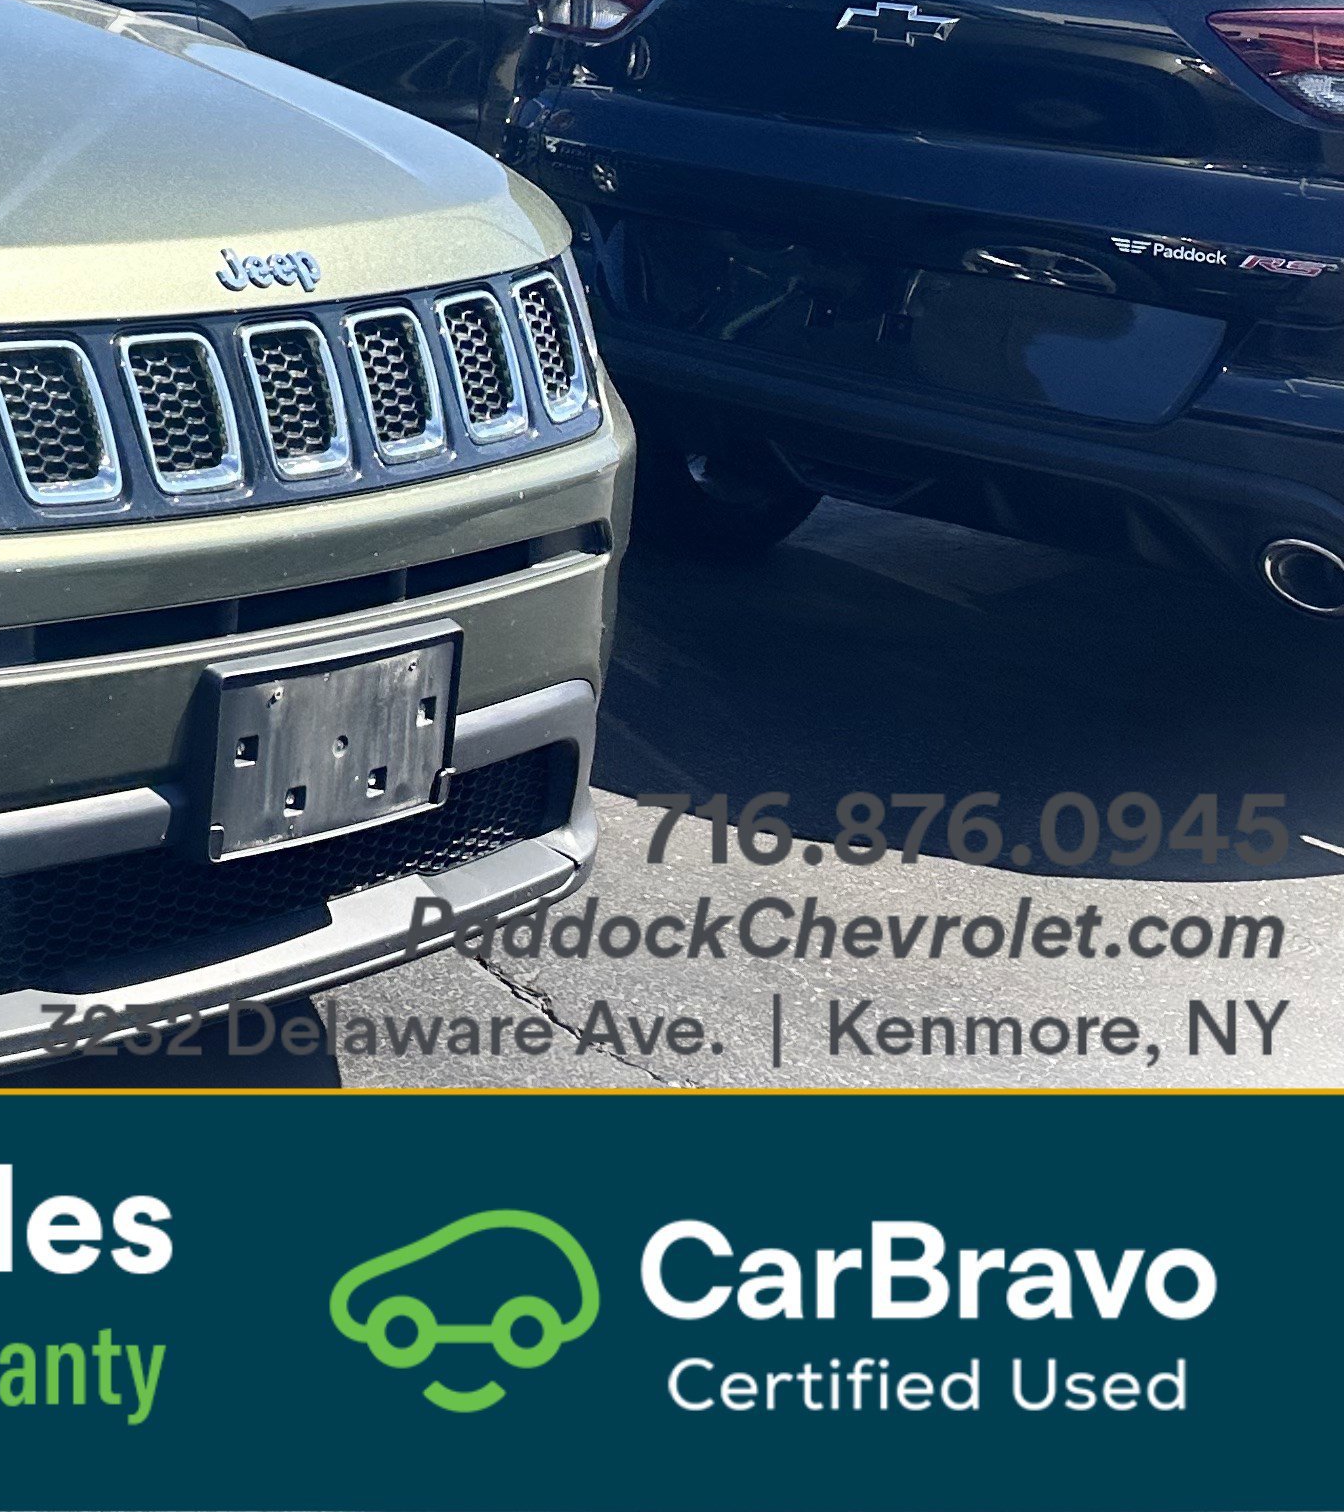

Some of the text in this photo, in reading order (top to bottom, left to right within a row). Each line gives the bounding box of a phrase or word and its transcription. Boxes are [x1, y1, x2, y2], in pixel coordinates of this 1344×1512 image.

[1153, 242, 1228, 266] Paddock
[1239, 254, 1327, 278] RS
[215, 247, 322, 293] Jeep
